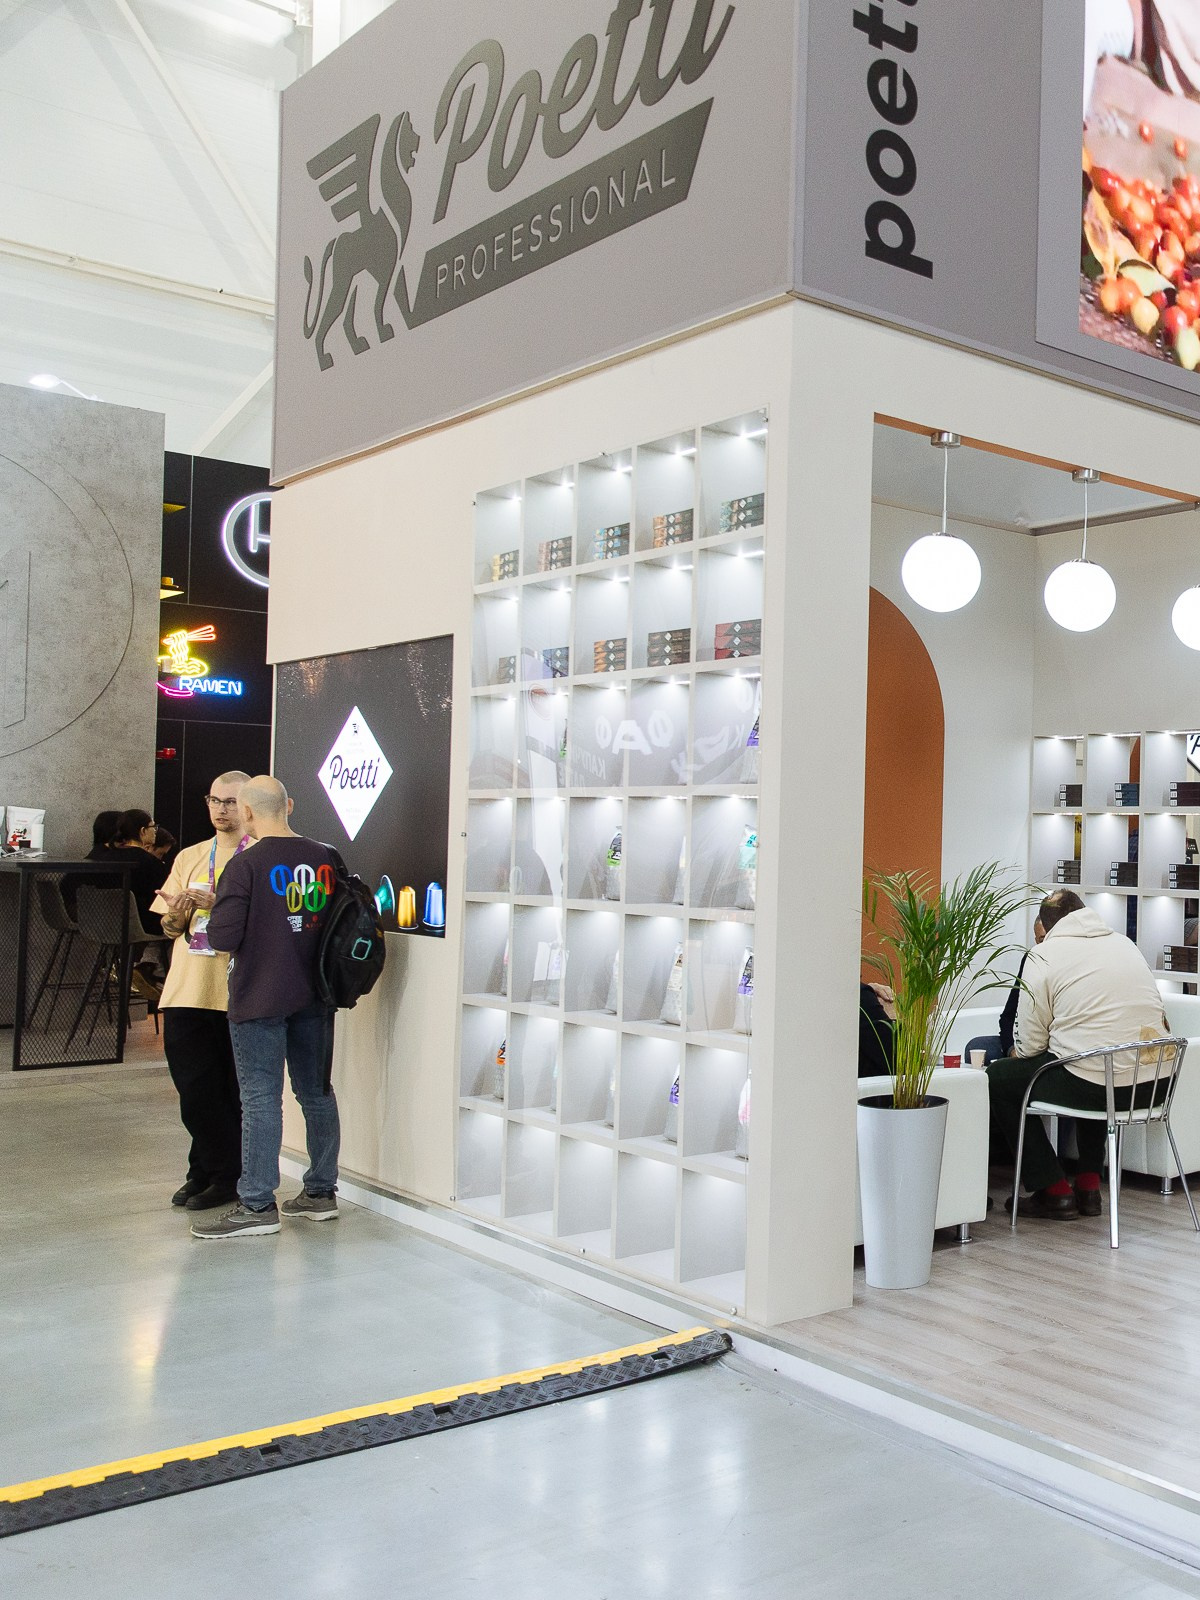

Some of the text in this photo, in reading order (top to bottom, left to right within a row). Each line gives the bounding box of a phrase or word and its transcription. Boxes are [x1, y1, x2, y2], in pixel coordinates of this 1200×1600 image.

[433, 0, 736, 224] Poetti
[853, 0, 933, 279] poet
[435, 148, 677, 299] PROFESSIONAL
[179, 675, 243, 696] RAMEN
[329, 754, 381, 790] Poetti
